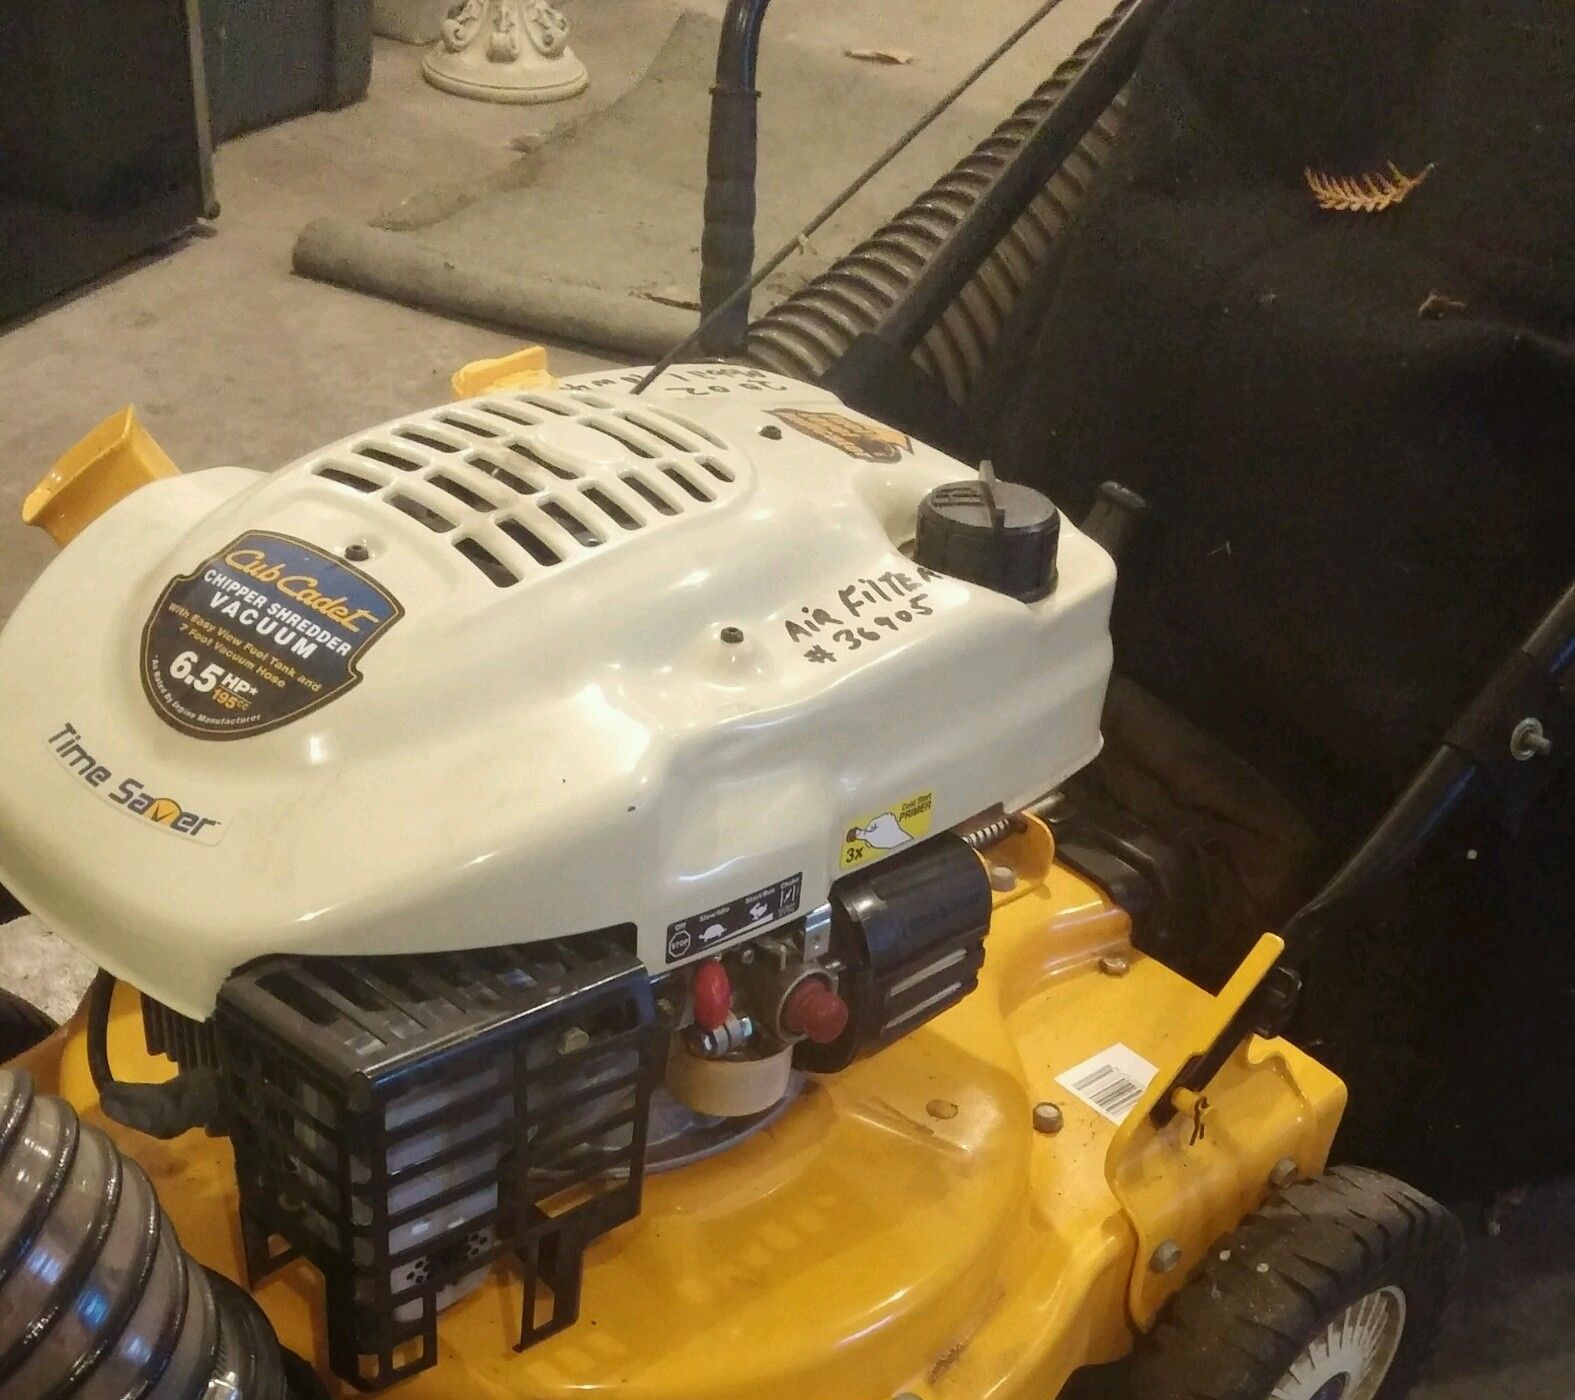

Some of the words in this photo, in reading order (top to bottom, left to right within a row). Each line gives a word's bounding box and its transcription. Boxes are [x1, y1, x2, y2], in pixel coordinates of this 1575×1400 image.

[204, 569, 268, 610] CHIPPER
[267, 602, 352, 657] SHREDDER
[224, 549, 287, 583] Cub
[276, 575, 380, 633] Cadet
[168, 602, 190, 618] With
[190, 613, 216, 632] Easy
[217, 627, 243, 646] View
[243, 642, 269, 661] Fuel
[269, 656, 297, 683] Tank
[297, 674, 323, 693] and
[208, 591, 318, 660] VACUUM
[169, 650, 226, 693] 6.5
[188, 628, 213, 646] Foot
[214, 642, 255, 670] Vacuum
[255, 665, 287, 689] Hose
[197, 713, 261, 725] Manufacturer
[48, 722, 112, 787] Time
[108, 777, 221, 836] Saver
[899, 800, 932, 822] PRIMER
[671, 938, 689, 951] STOP
